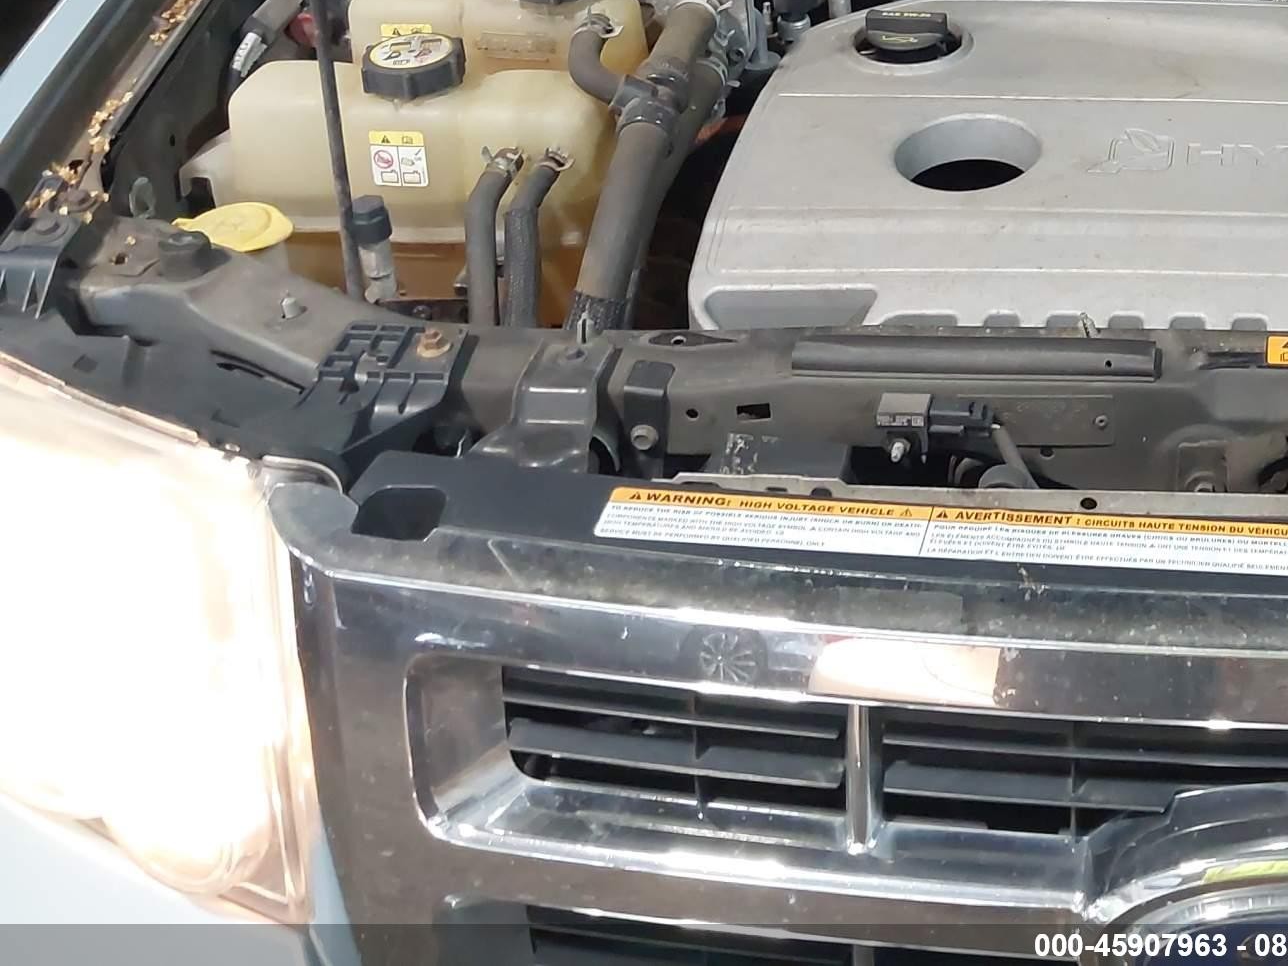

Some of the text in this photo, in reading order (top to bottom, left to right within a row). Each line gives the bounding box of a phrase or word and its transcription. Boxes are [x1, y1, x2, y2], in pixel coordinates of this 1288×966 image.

[645, 493, 895, 516] WARNING: HIGH VOLTAGE VEHICLE
[954, 511, 1071, 524] AVERTISSEMENT
[1084, 518, 1134, 528] CIRCUITS
[1138, 521, 1174, 530] HAUTE
[1178, 524, 1225, 532] TENSION
